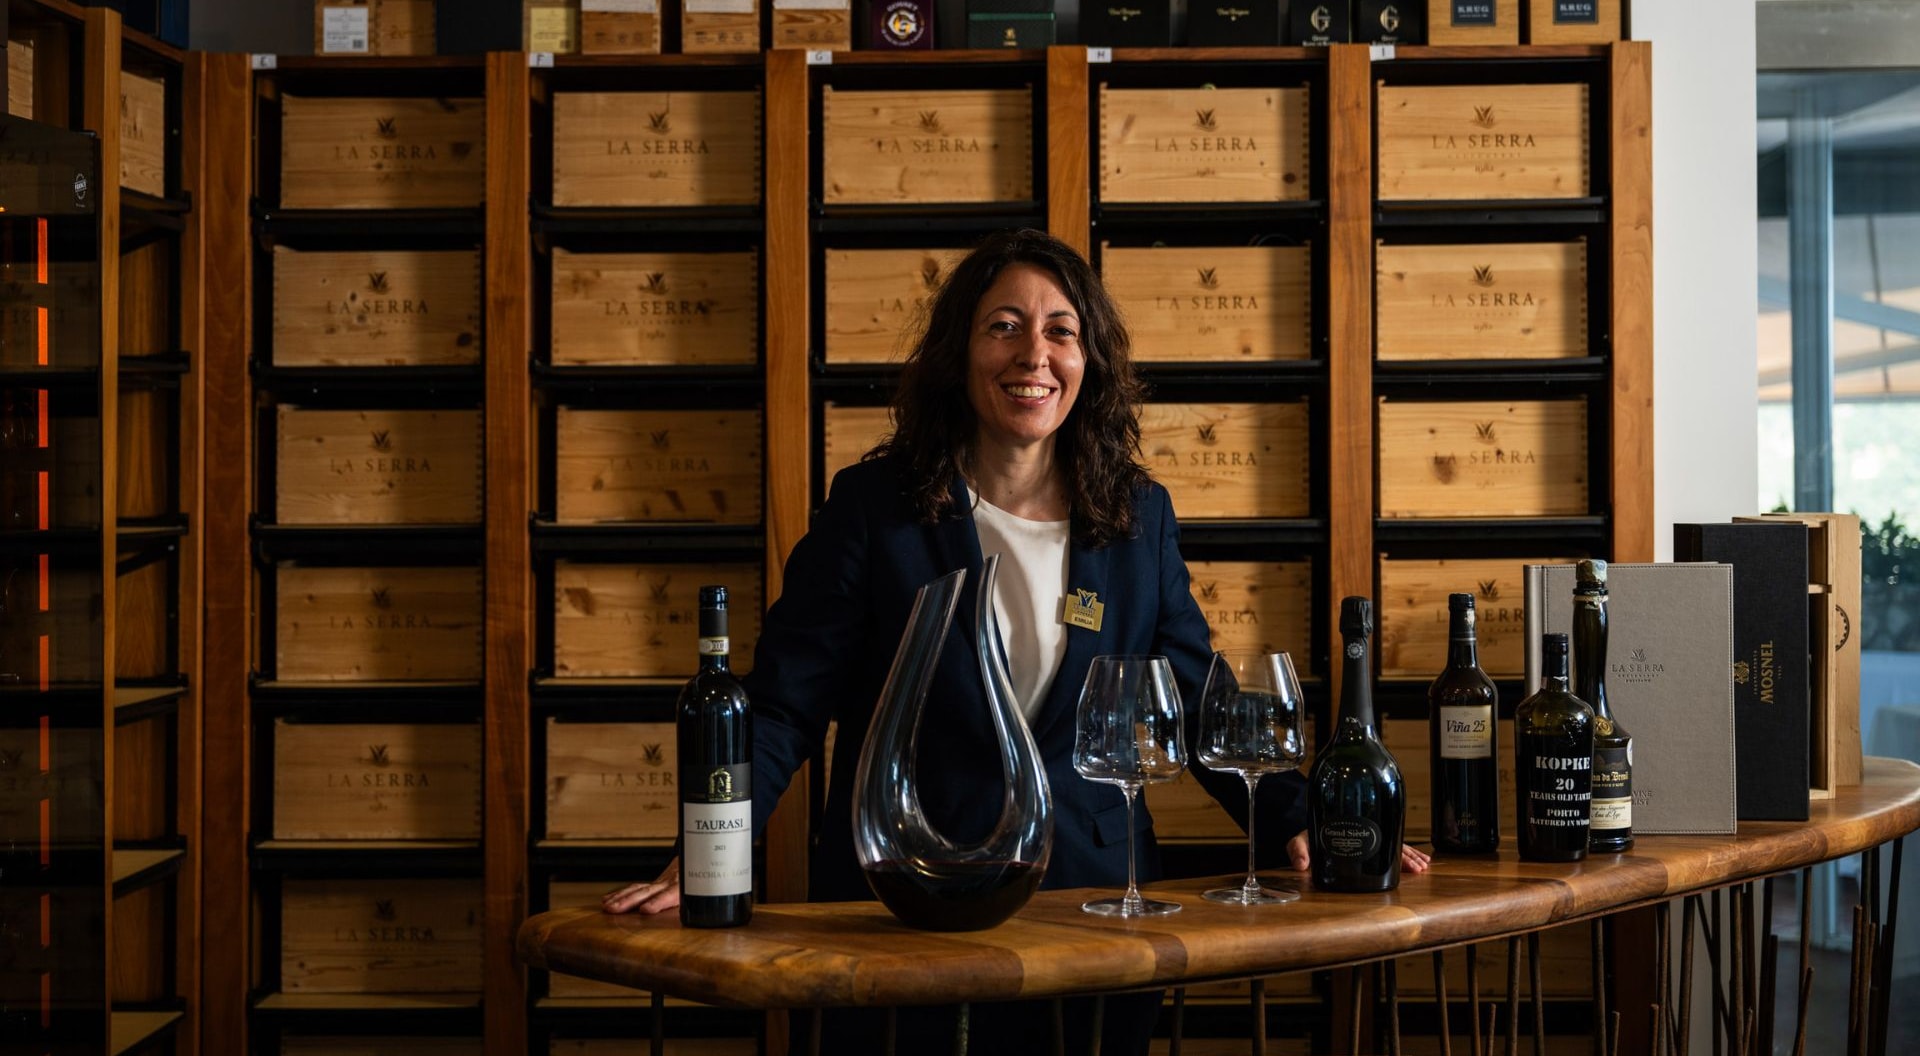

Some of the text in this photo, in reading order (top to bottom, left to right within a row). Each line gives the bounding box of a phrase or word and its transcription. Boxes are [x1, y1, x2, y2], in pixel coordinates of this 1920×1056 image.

[1458, 5, 1489, 13] KRUG
[537, 54, 545, 66] F
[1097, 51, 1105, 60] H
[607, 140, 710, 154] LA SERRA
[879, 138, 980, 153] LA SERRA
[1154, 138, 1257, 152] LA SERRA
[1432, 133, 1536, 149] LA SERRA
[336, 145, 437, 159] LA SERRA
[326, 299, 429, 314] LA SERRA
[1155, 295, 1258, 310] LA SERRA
[1431, 292, 1535, 307] LA SERRA
[605, 301, 707, 315] LA SERRA
[647, 457, 711, 471] SERRA
[1154, 452, 1257, 466] LA SERRA
[1470, 450, 1537, 464] SERRA
[330, 457, 432, 472] LA SERRA
[329, 615, 432, 629] LA SERRA
[644, 611, 698, 625] SERR
[1074, 616, 1093, 626] EMILIA
[1205, 610, 1259, 624] ERRA
[1611, 663, 1665, 673] LA SERRA
[1760, 639, 1774, 704] MOSNEL
[1446, 719, 1486, 733] Viña 25
[1535, 755, 1591, 771] KOPKE
[328, 773, 431, 787] LA SERRA
[637, 771, 675, 786] SER
[1555, 777, 1575, 791] 20
[1529, 791, 1556, 801] YEARS
[1546, 808, 1580, 817] PORTO
[695, 818, 744, 830] TAURASI
[1529, 817, 1566, 826] MATURED
[1567, 819, 1575, 827] IN
[335, 927, 435, 942] LA SERRA
